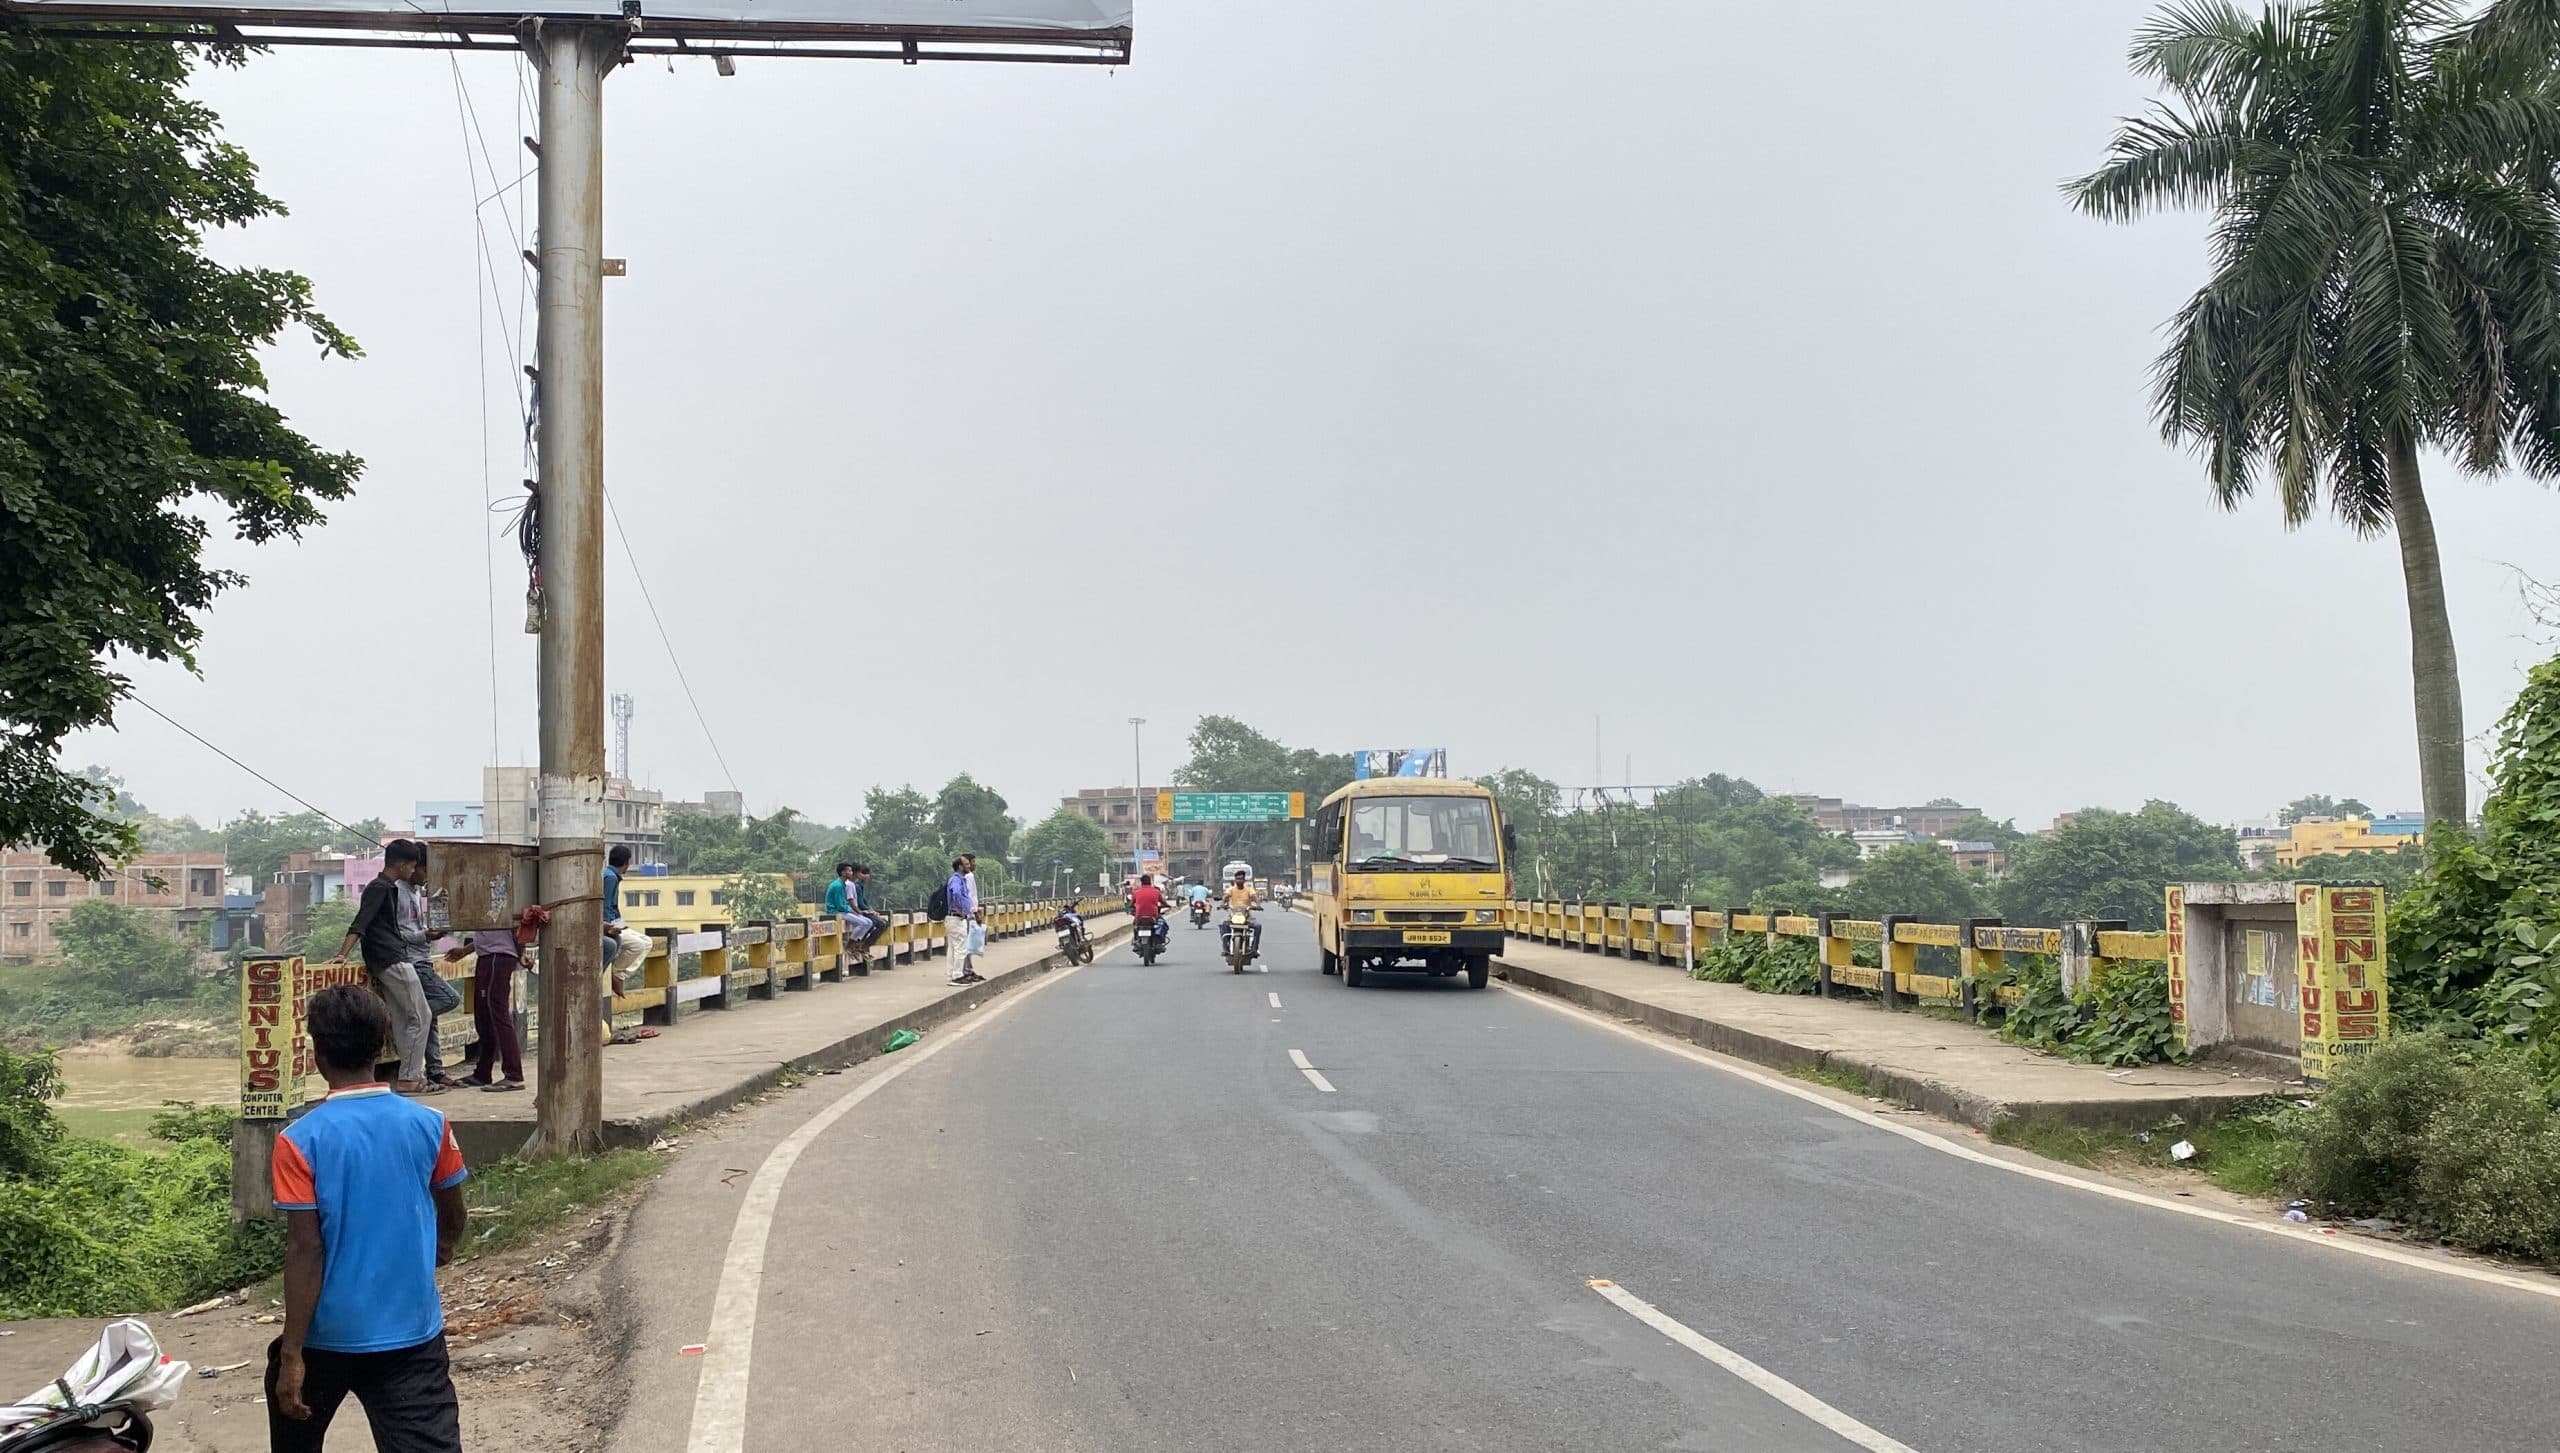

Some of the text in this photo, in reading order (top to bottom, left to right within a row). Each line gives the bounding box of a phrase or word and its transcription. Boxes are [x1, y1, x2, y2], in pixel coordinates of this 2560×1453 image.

[2169, 890, 2185, 1023] GENIUS
[2299, 888, 2322, 1038] GNIUS
[2330, 891, 2380, 1041] GENIUS
[247, 962, 282, 1093] GENIUS
[290, 957, 306, 1078] GENIUS
[2302, 1056, 2324, 1074] CENTRE
[2329, 1042, 2374, 1057] COMPUT
[242, 1093, 283, 1104] COMPUTER
[244, 1104, 279, 1117] CENTRE
